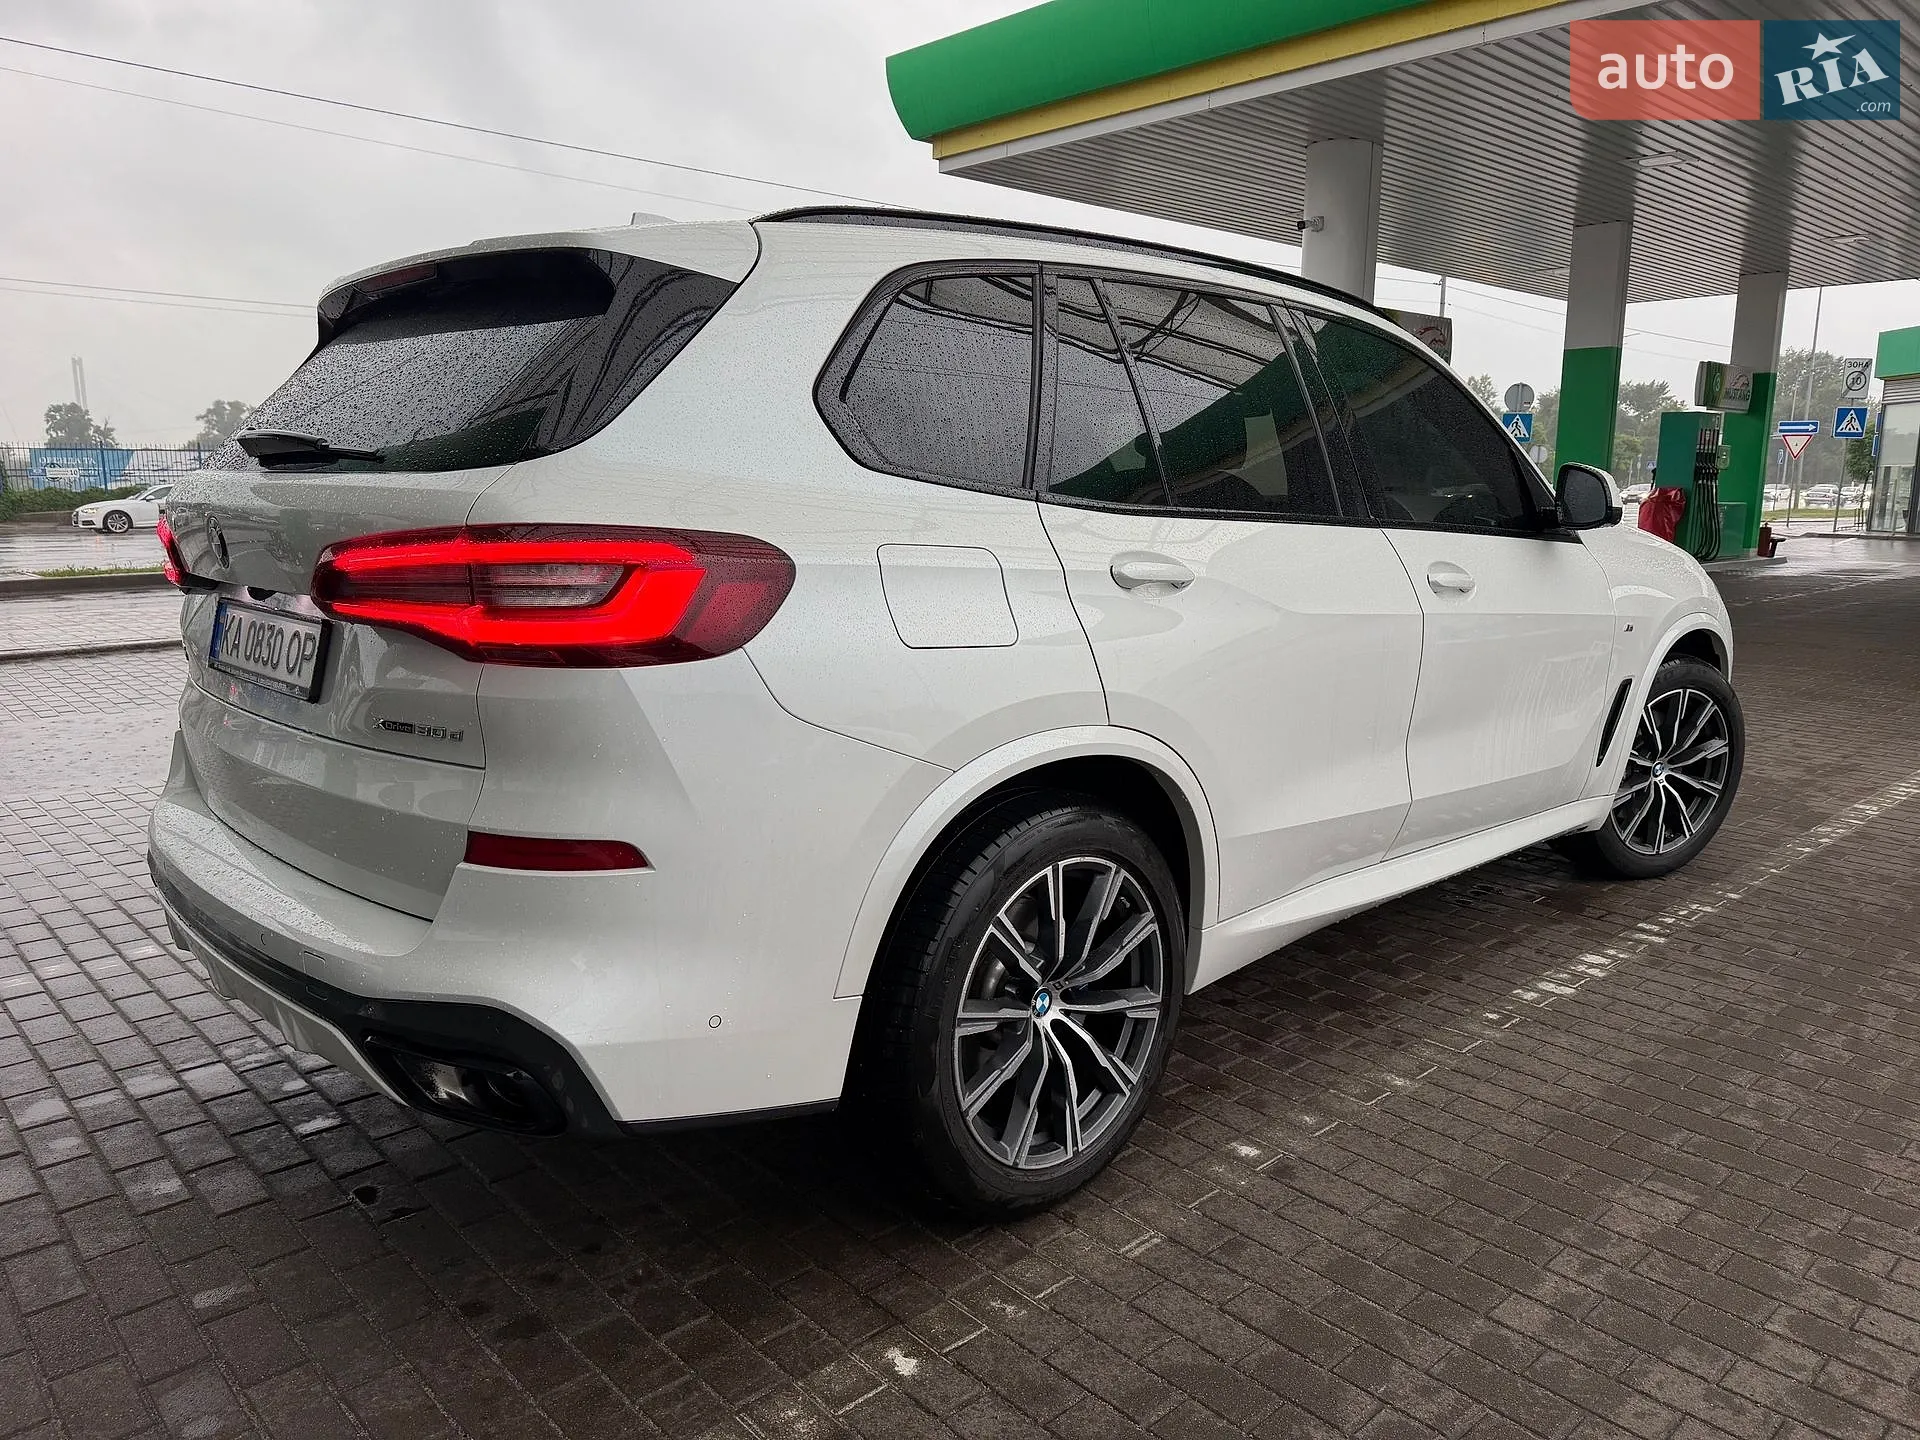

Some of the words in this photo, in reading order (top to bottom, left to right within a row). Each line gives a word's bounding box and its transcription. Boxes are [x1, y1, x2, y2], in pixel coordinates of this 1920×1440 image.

[1847, 361, 1869, 369] ЗОНА
[220, 612, 243, 660] KA
[244, 619, 285, 670] 0830
[286, 629, 317, 679] OP
